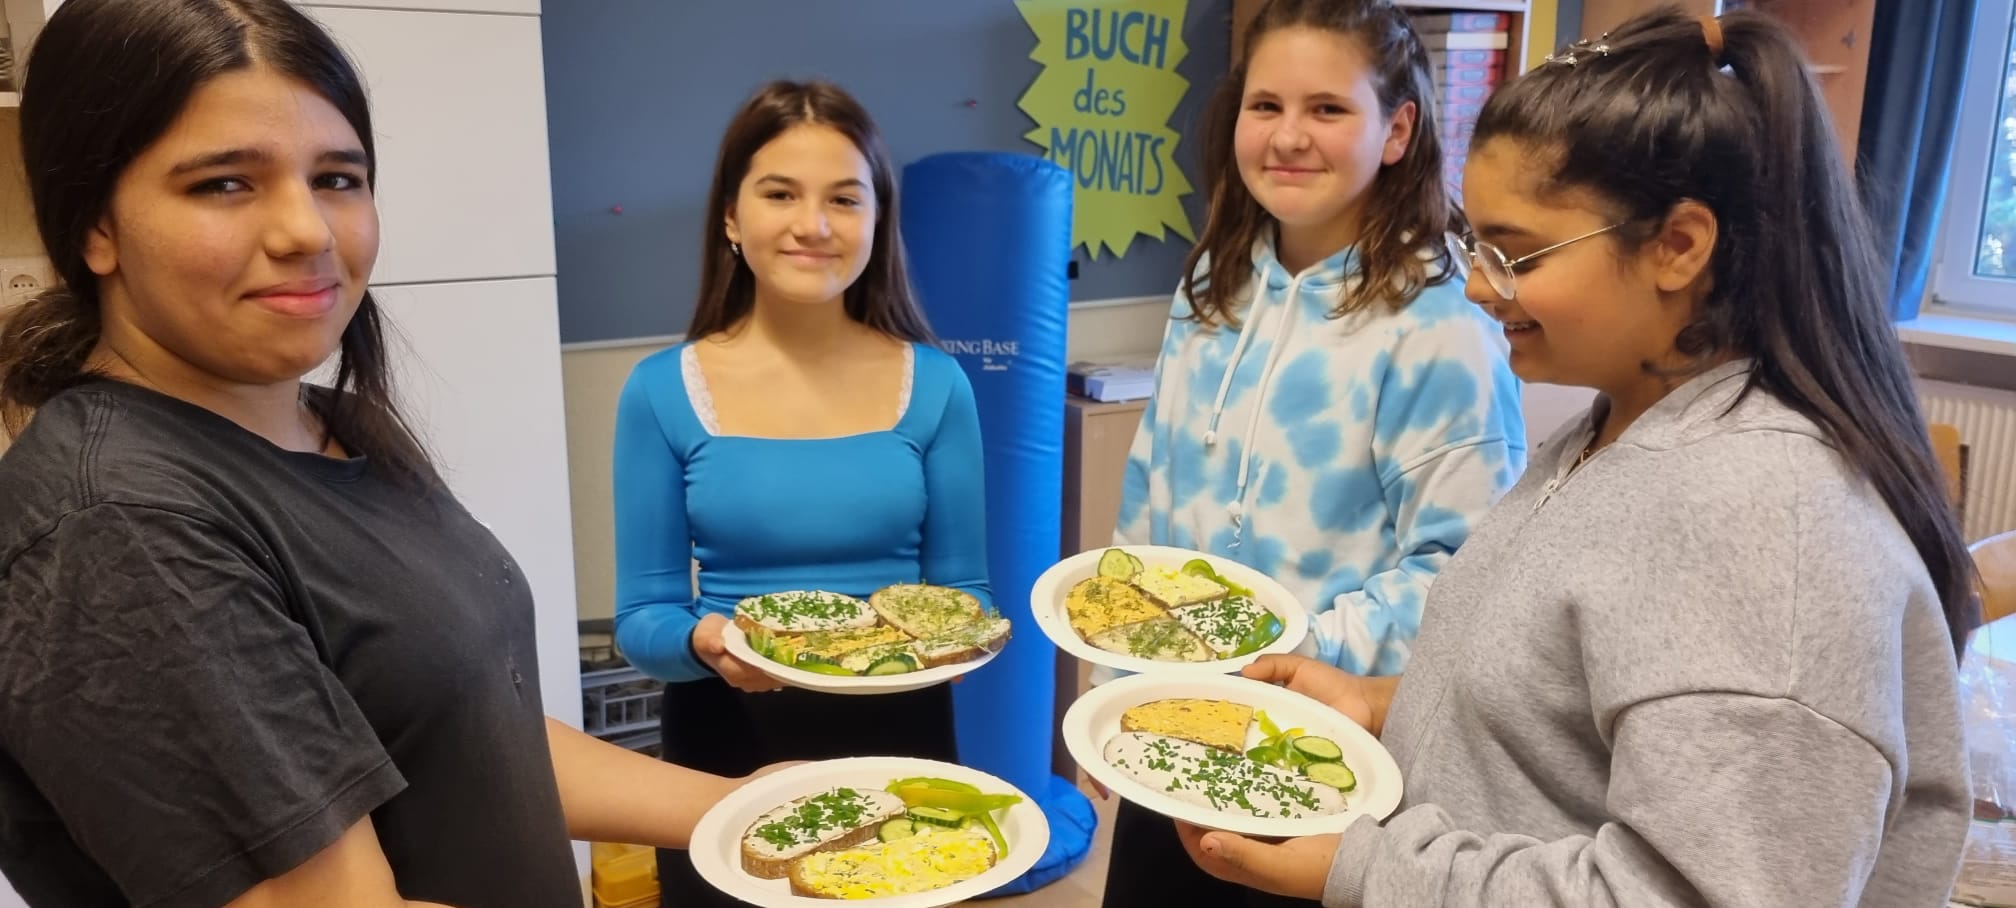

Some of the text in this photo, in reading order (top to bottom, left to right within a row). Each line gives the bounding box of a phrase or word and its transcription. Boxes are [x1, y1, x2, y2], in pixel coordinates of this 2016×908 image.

[1065, 8, 1170, 69] BUCH
[1073, 68, 1126, 116] des
[1050, 127, 1165, 196] MONATS
[982, 339, 1019, 355] BASE
